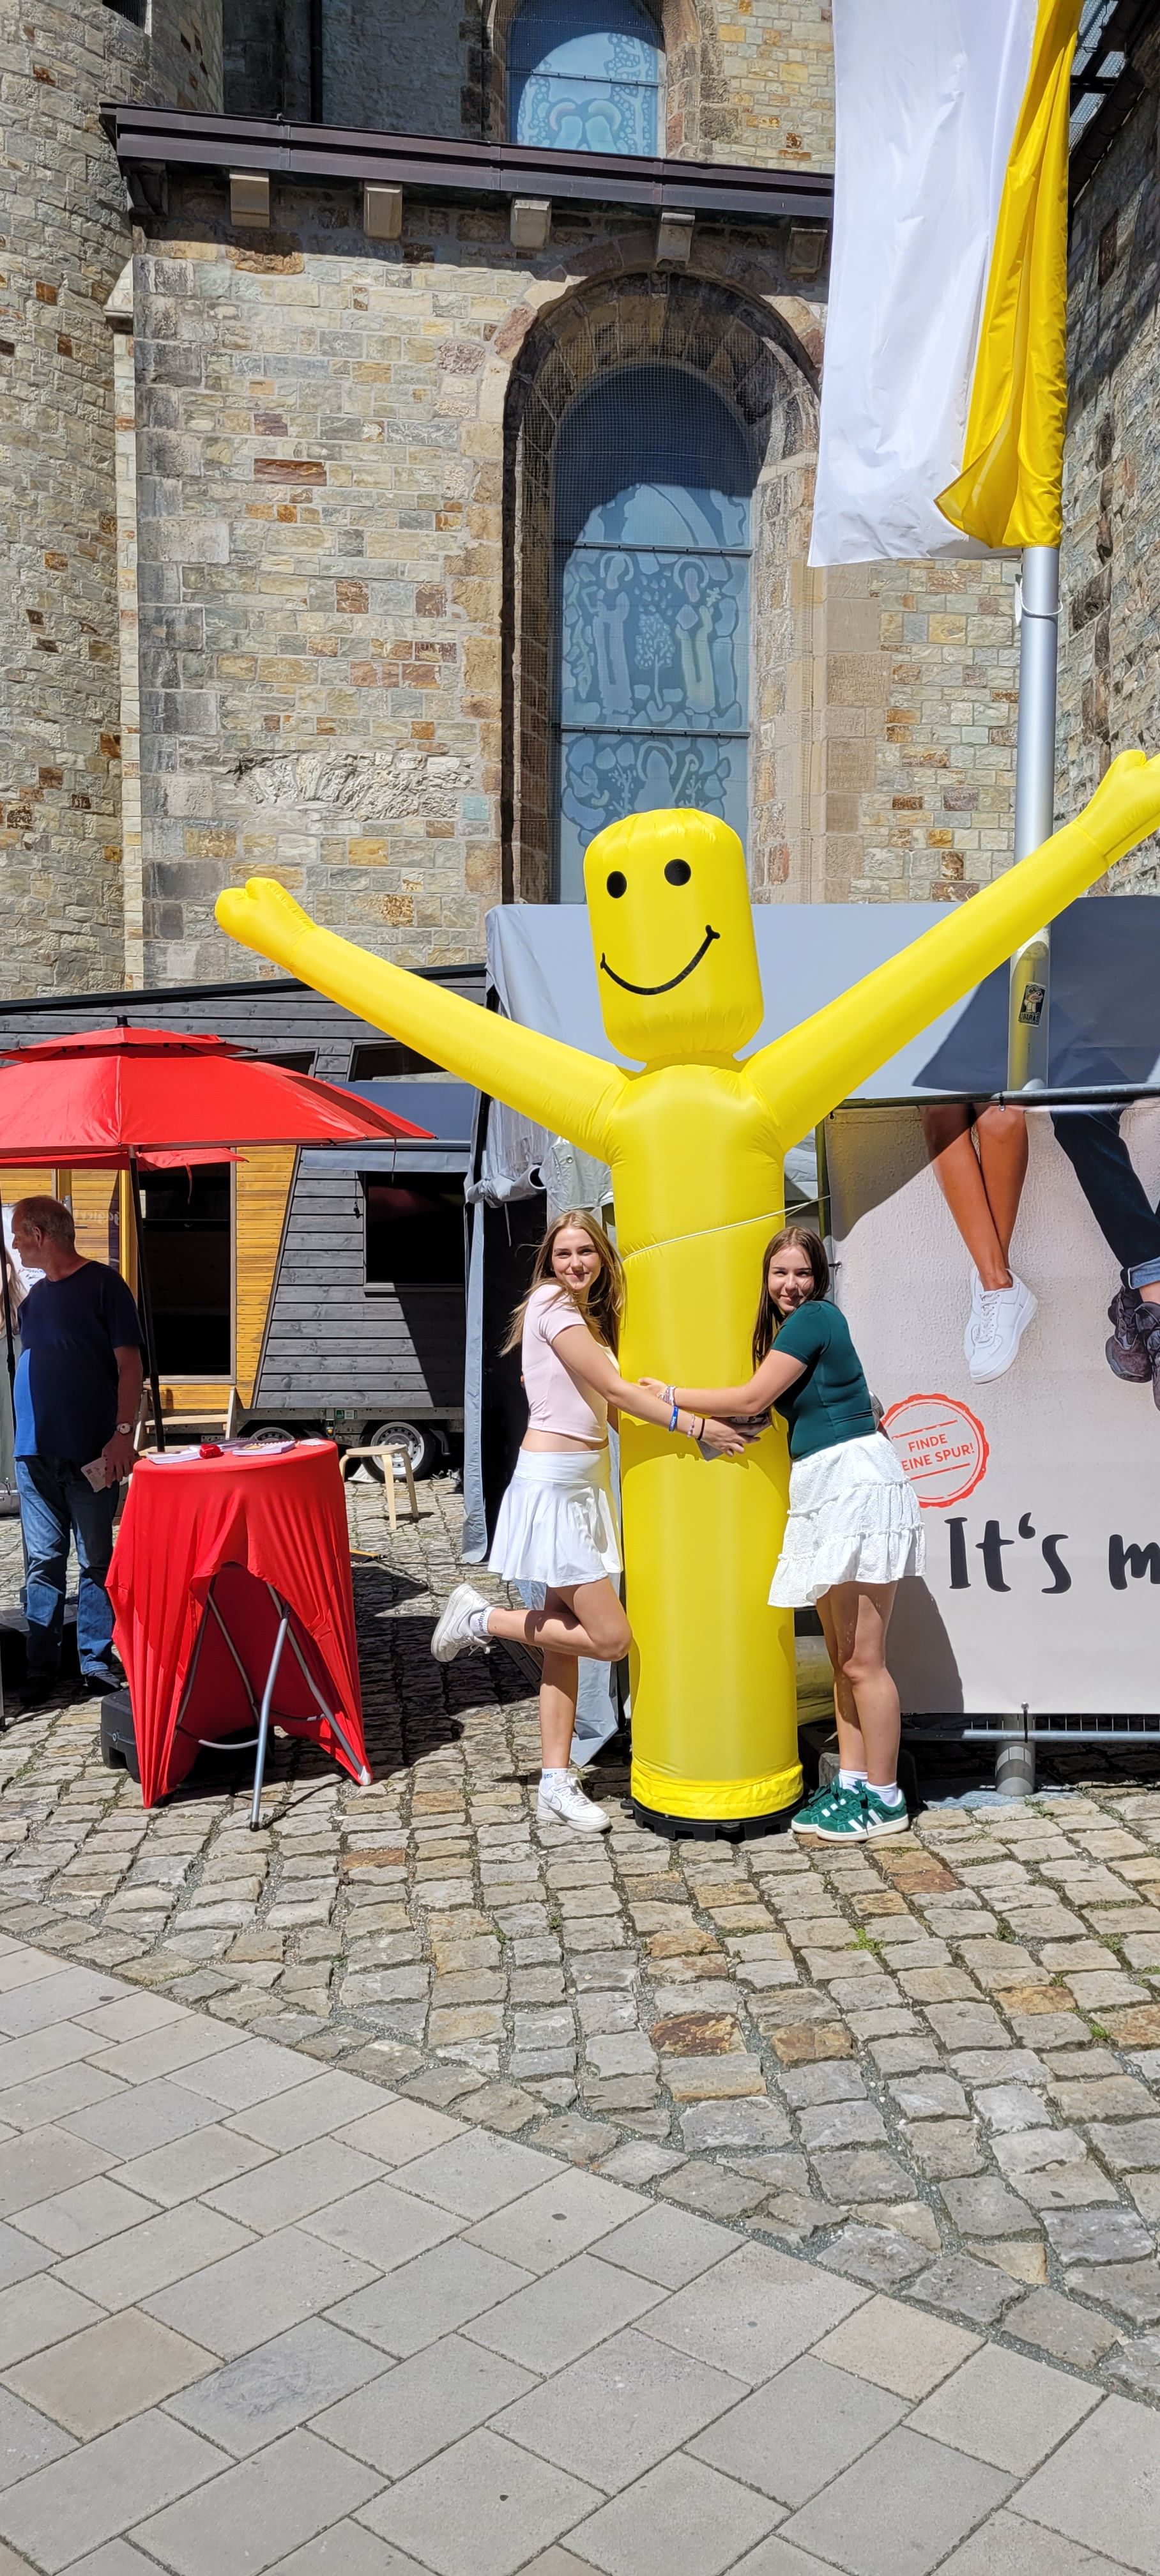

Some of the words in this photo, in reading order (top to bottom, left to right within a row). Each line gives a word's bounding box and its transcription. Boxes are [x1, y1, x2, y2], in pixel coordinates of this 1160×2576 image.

[908, 1434, 948, 1452] FINDE
[901, 1454, 933, 1471] EINE
[935, 1443, 975, 1462] SPUR!
